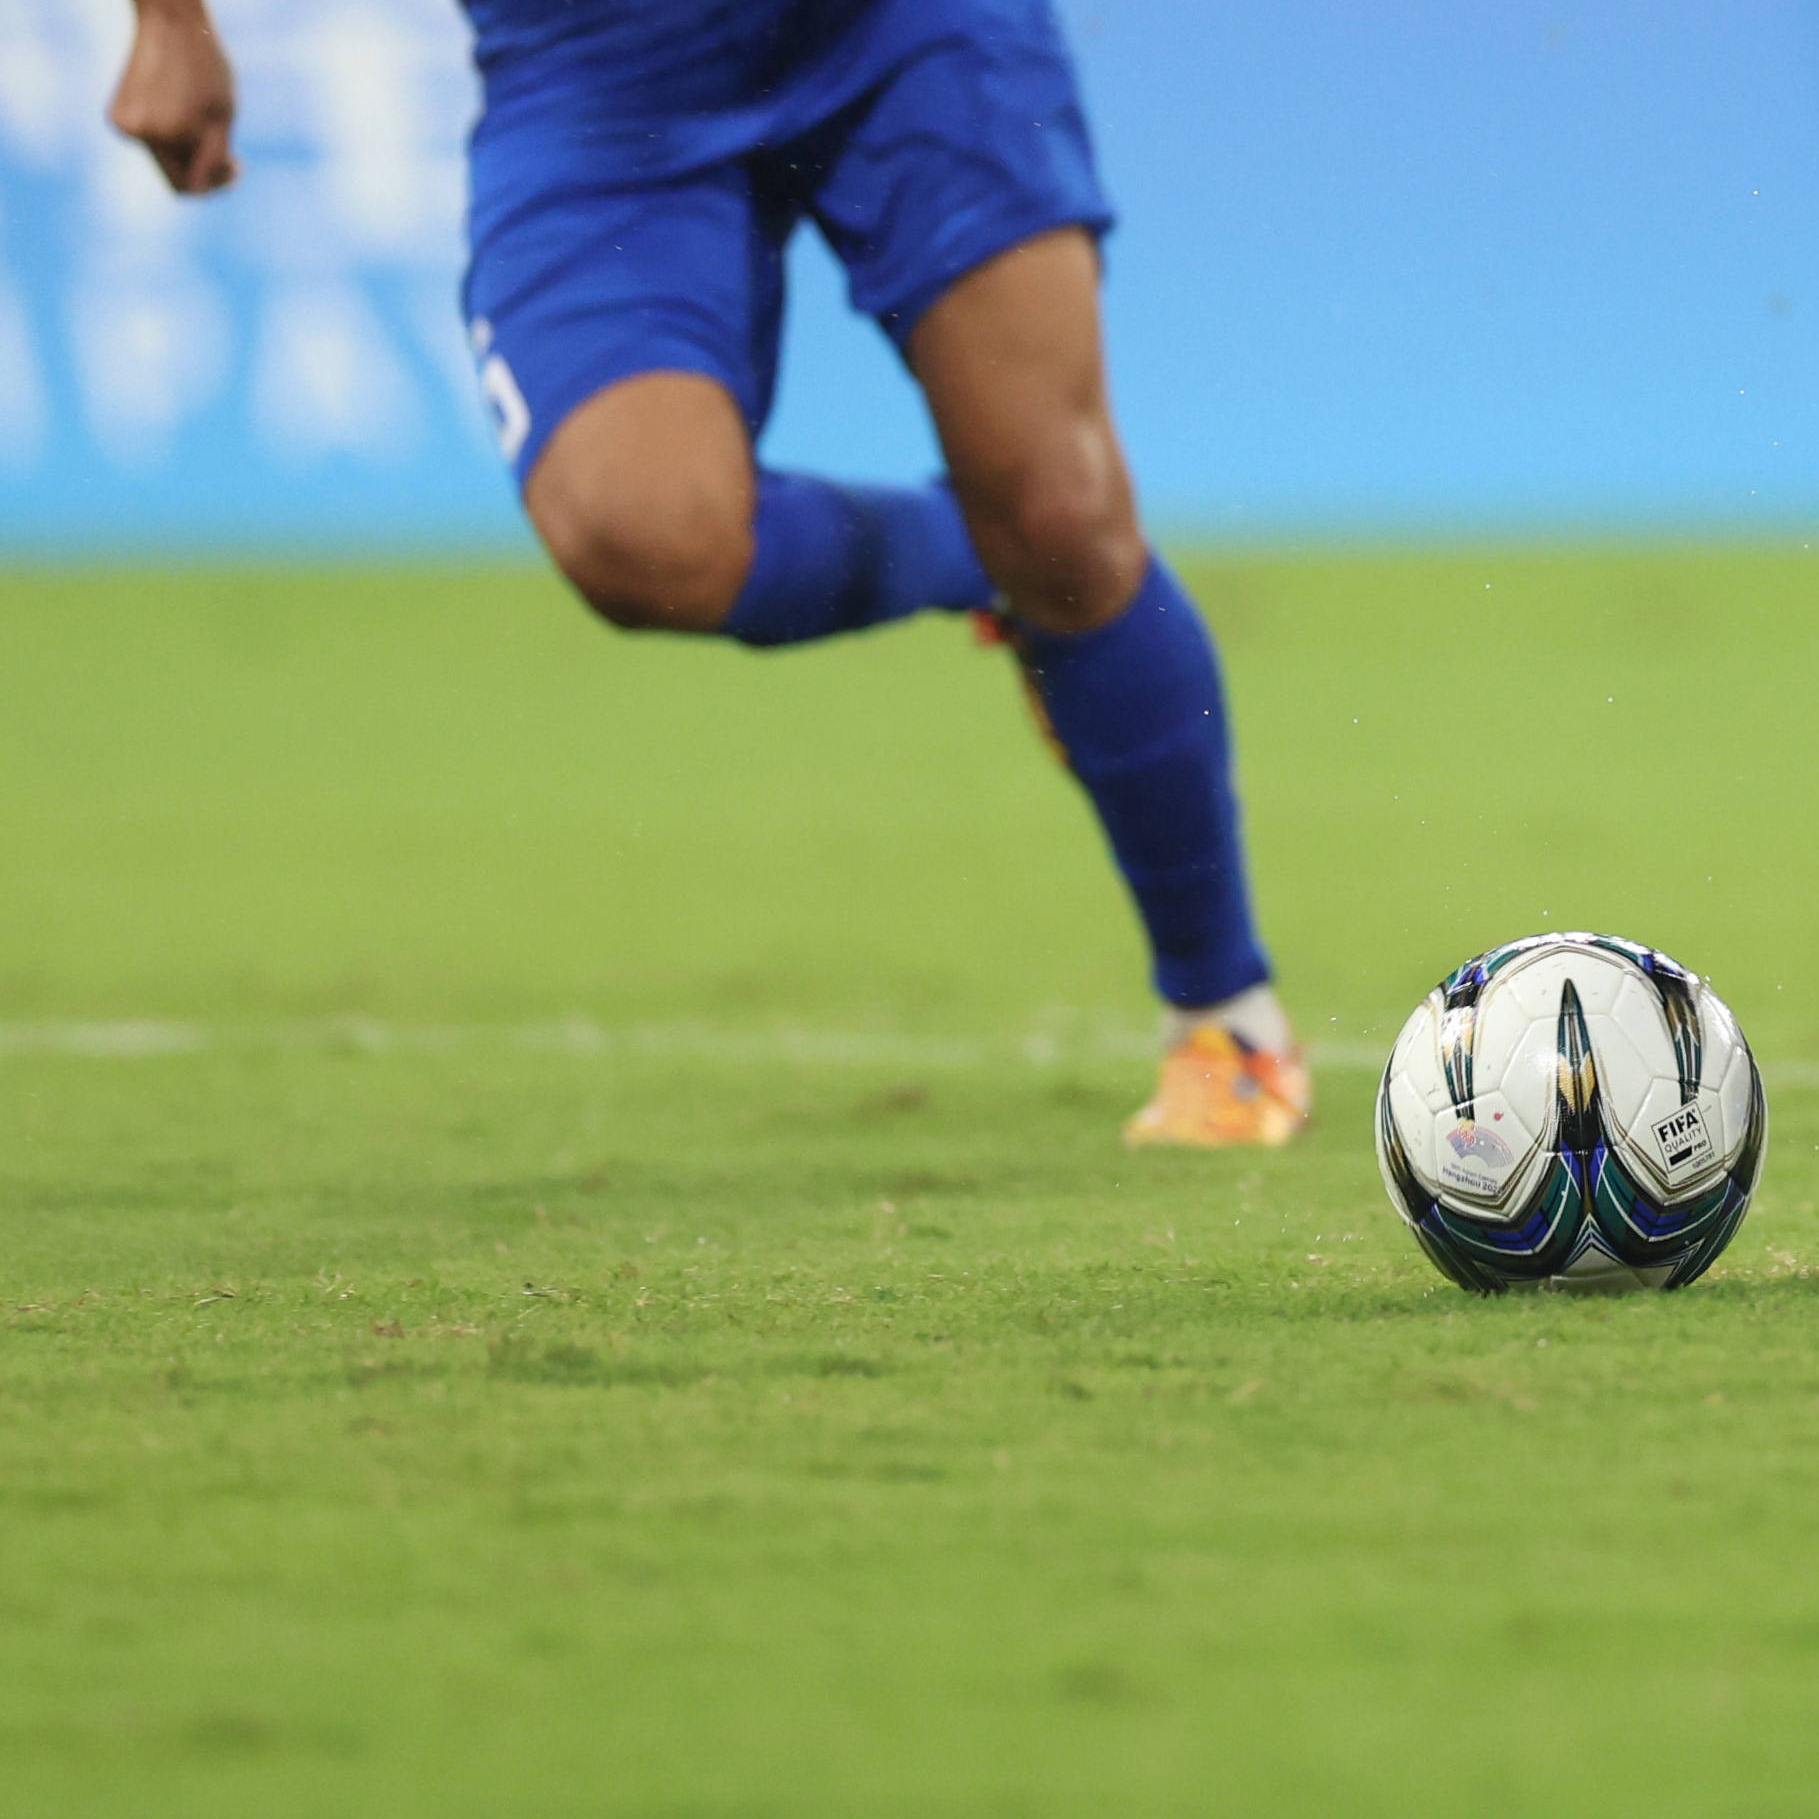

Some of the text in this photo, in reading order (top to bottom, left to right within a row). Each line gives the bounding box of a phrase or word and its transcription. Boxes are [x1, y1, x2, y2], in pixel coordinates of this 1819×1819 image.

[1658, 1111, 1699, 1142] FIFA
[1664, 1128, 1702, 1153] QUALITY
[1694, 1140, 1707, 1151] PRO
